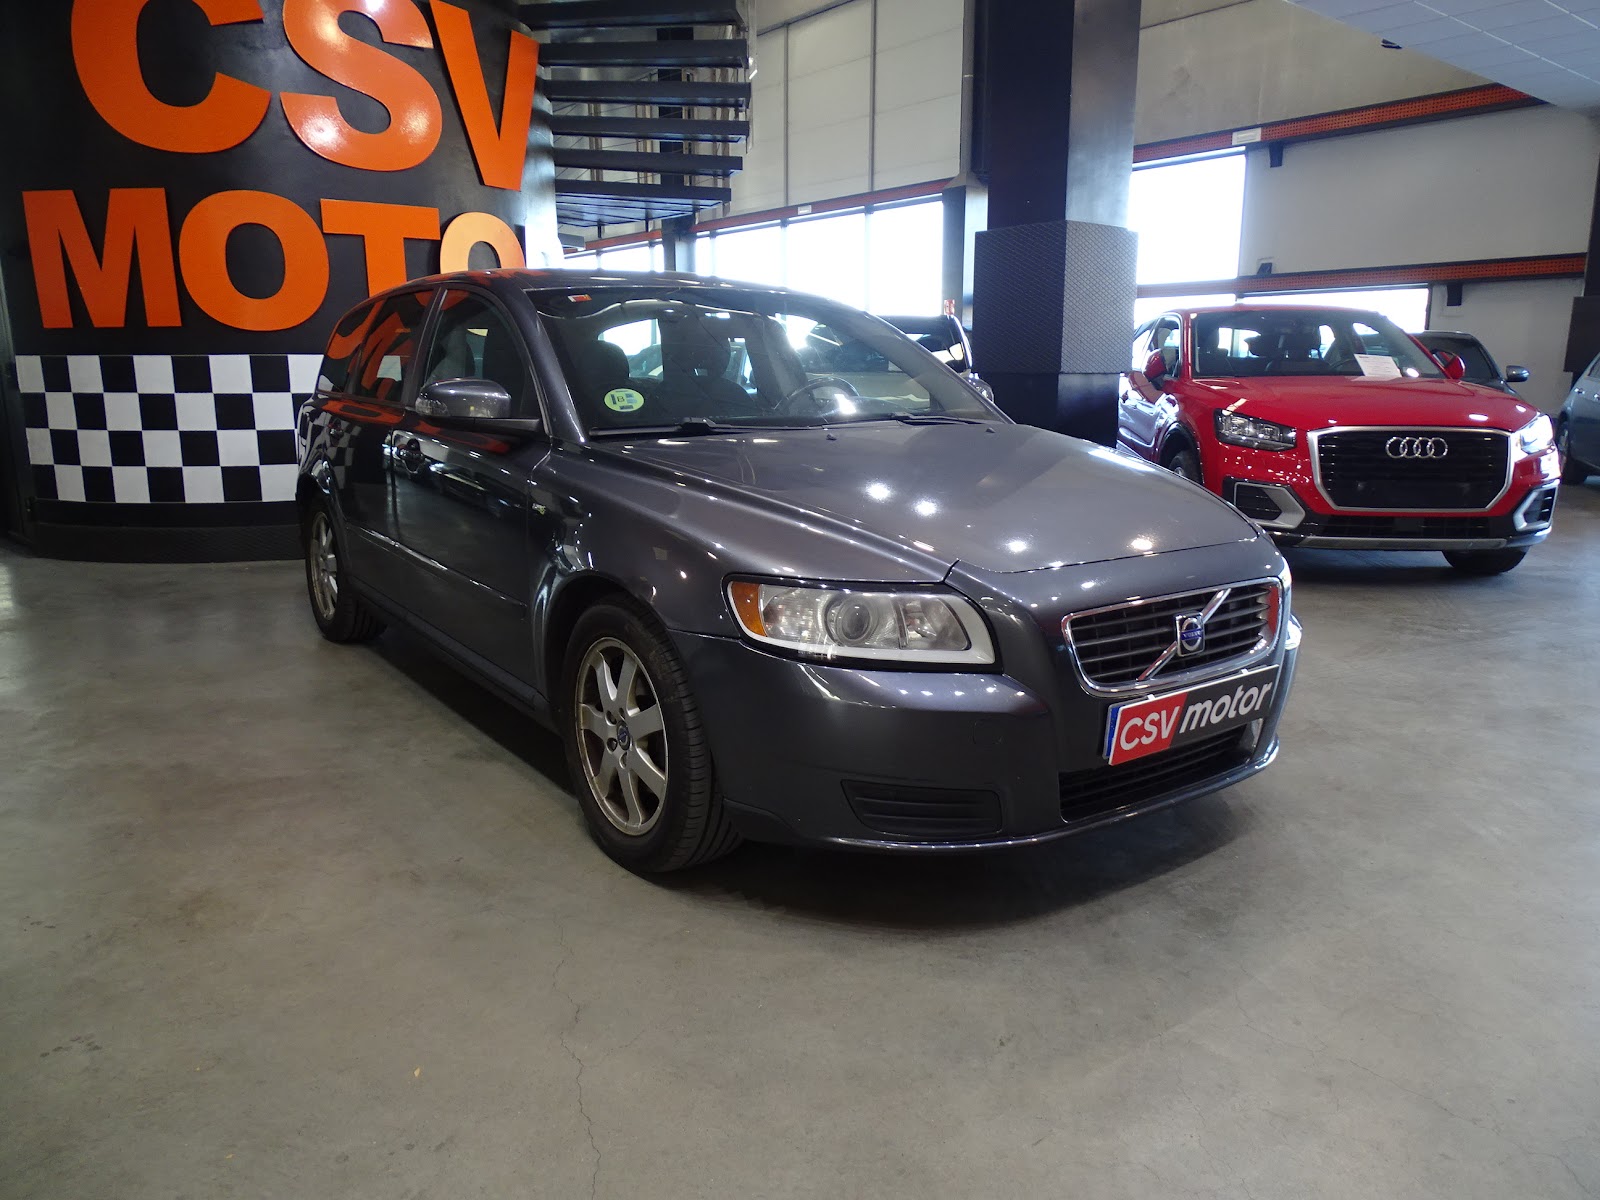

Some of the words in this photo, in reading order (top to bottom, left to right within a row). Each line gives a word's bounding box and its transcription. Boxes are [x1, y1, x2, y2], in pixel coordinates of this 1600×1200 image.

[71, 0, 539, 191] CSV
[1120, 706, 1180, 750] CSV
[1179, 682, 1273, 734] motor
